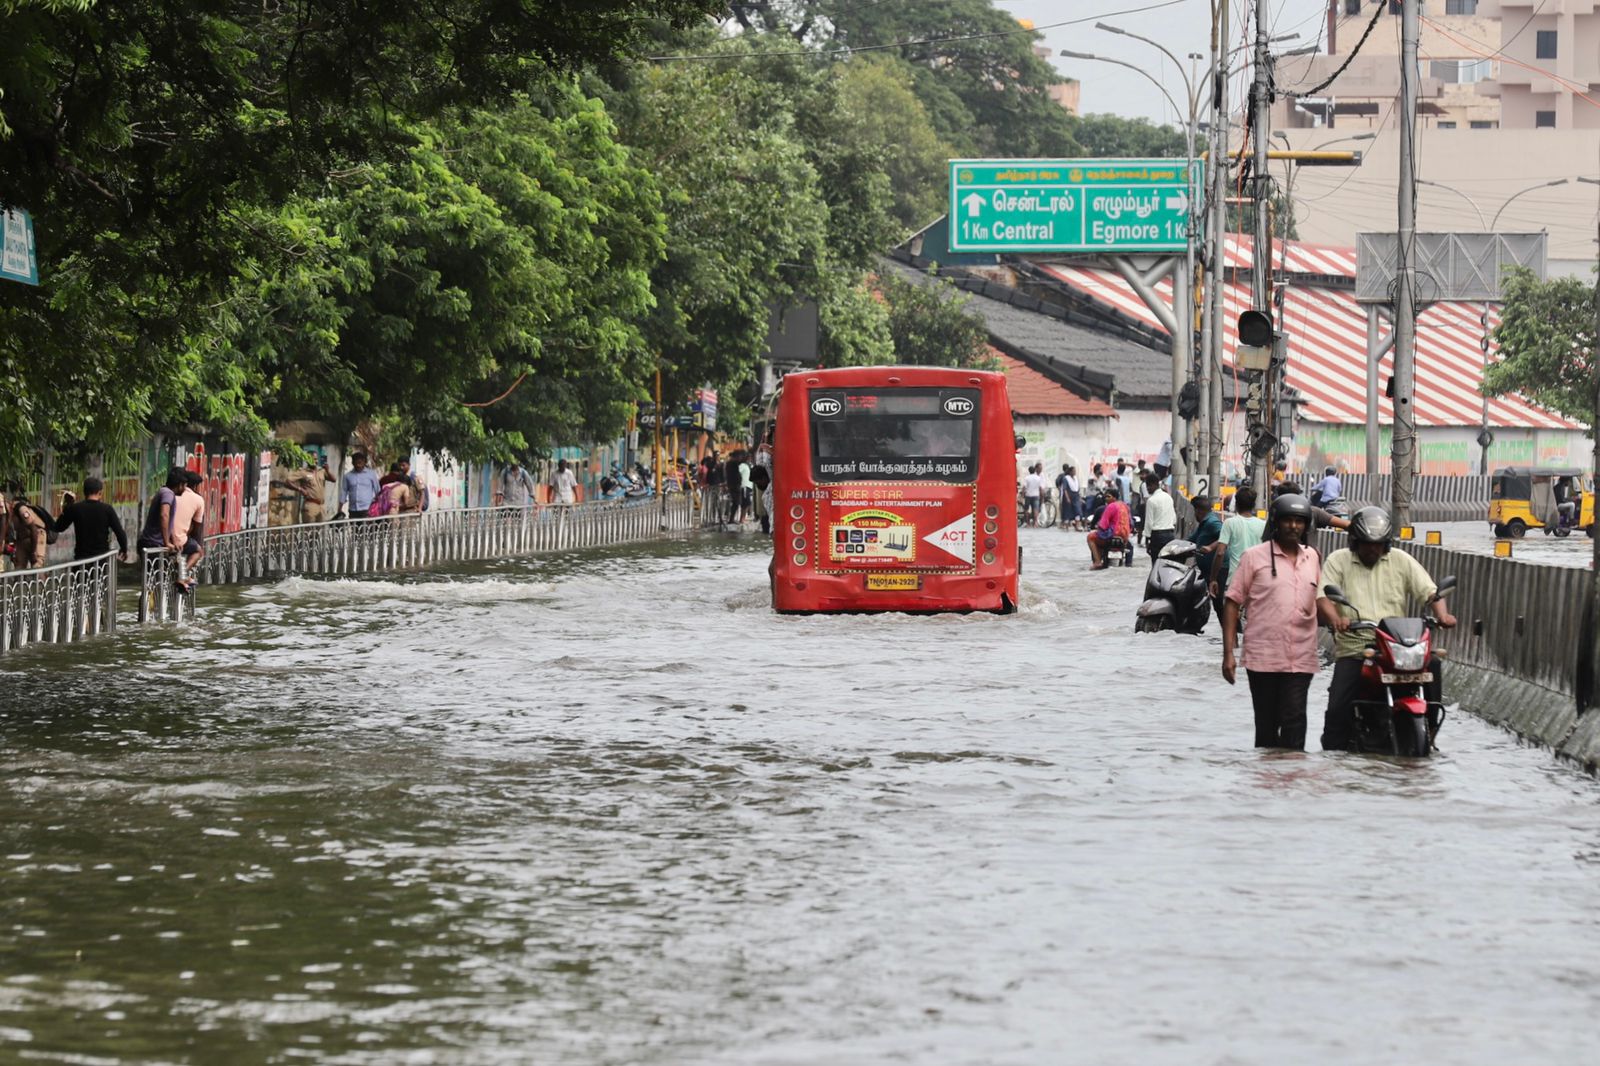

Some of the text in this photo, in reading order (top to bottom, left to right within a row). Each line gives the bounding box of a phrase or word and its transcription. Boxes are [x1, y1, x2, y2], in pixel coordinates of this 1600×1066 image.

[992, 188, 1075, 215] சென்ட்ரல்
[1093, 189, 1160, 219] எழும்பூர்
[962, 219, 1054, 240] 1 Km Central
[1092, 220, 1159, 244] Egmore
[1164, 219, 1171, 240] 1
[815, 402, 839, 412] MTC
[947, 401, 971, 411] MTC
[820, 461, 856, 475] மாநகர்
[935, 460, 967, 475] கழகம்
[831, 489, 904, 500] SUPER STAR
[1198, 478, 1208, 497] 2
[940, 530, 968, 542] ACT
